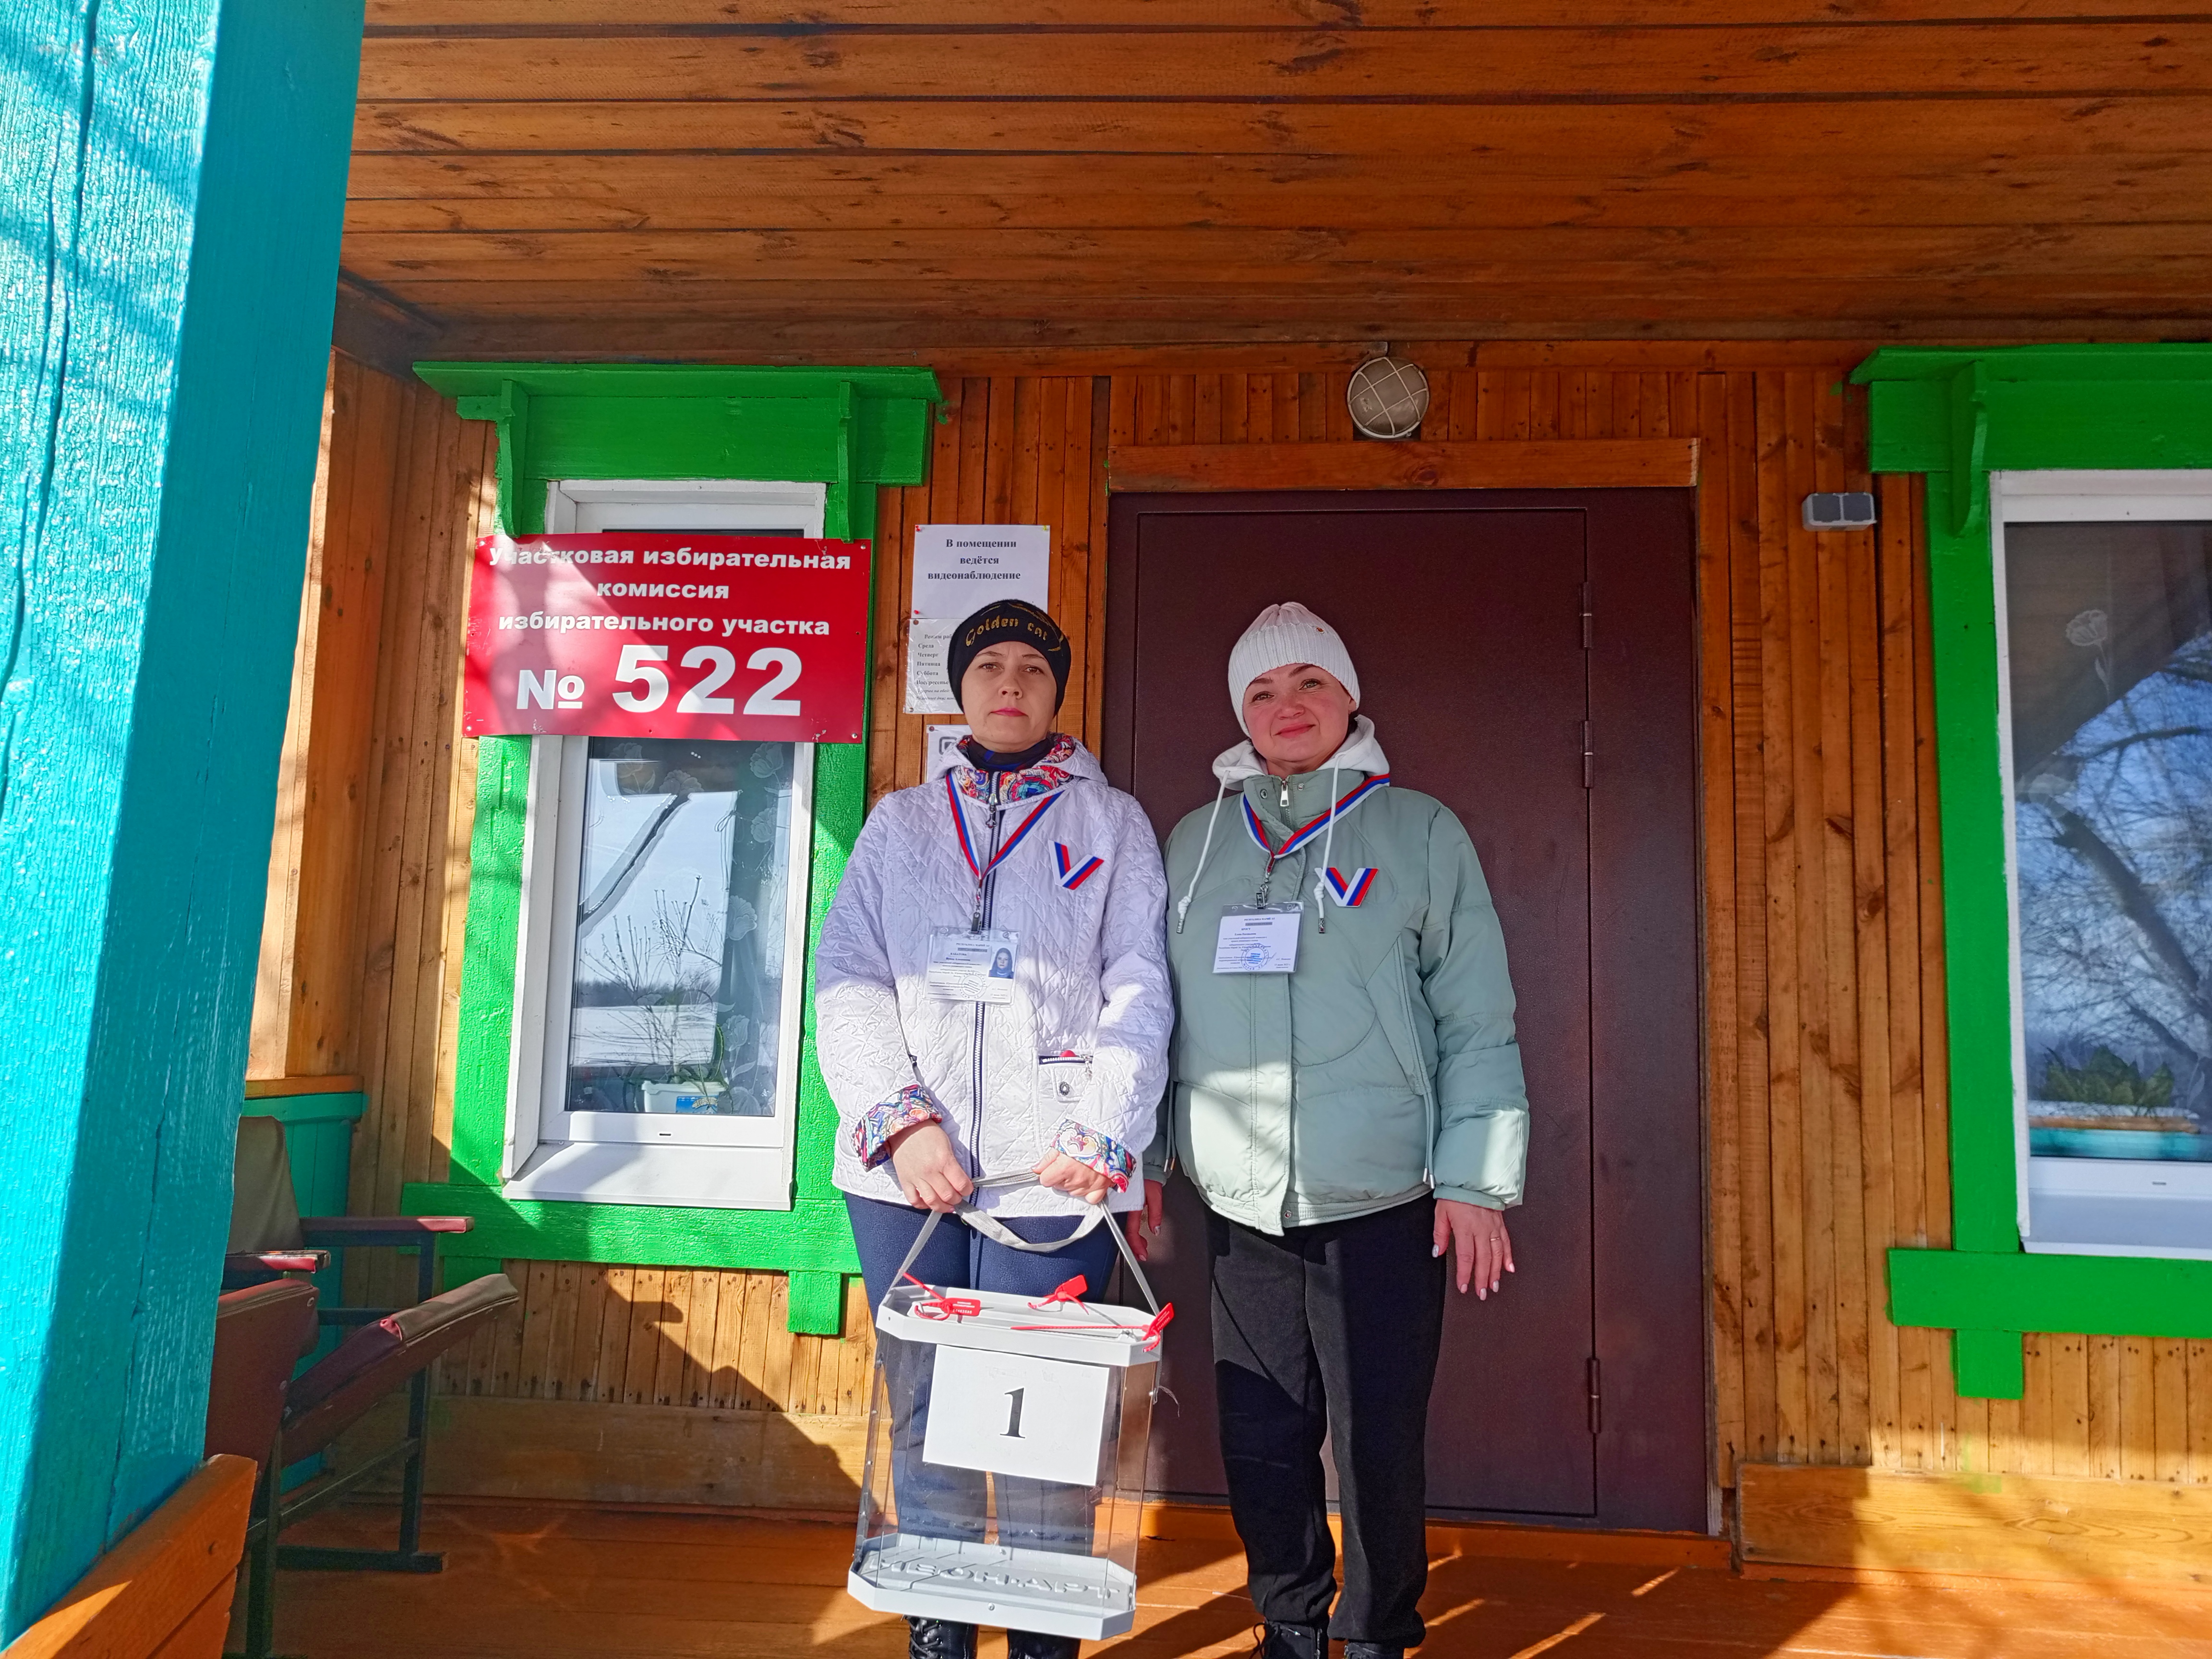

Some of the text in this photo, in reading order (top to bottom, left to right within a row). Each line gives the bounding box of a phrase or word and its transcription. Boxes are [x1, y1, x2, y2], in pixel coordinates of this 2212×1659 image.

[946, 539, 1017, 549] В помещении
[643, 546, 851, 570] избирательная
[960, 555, 999, 565] ведётся
[927, 571, 1021, 580] видеонаблюдение
[597, 580, 730, 600] комиссия
[498, 611, 830, 638] избирательного участка
[516, 644, 803, 717] № 522
[999, 1387, 1026, 1440] 1
